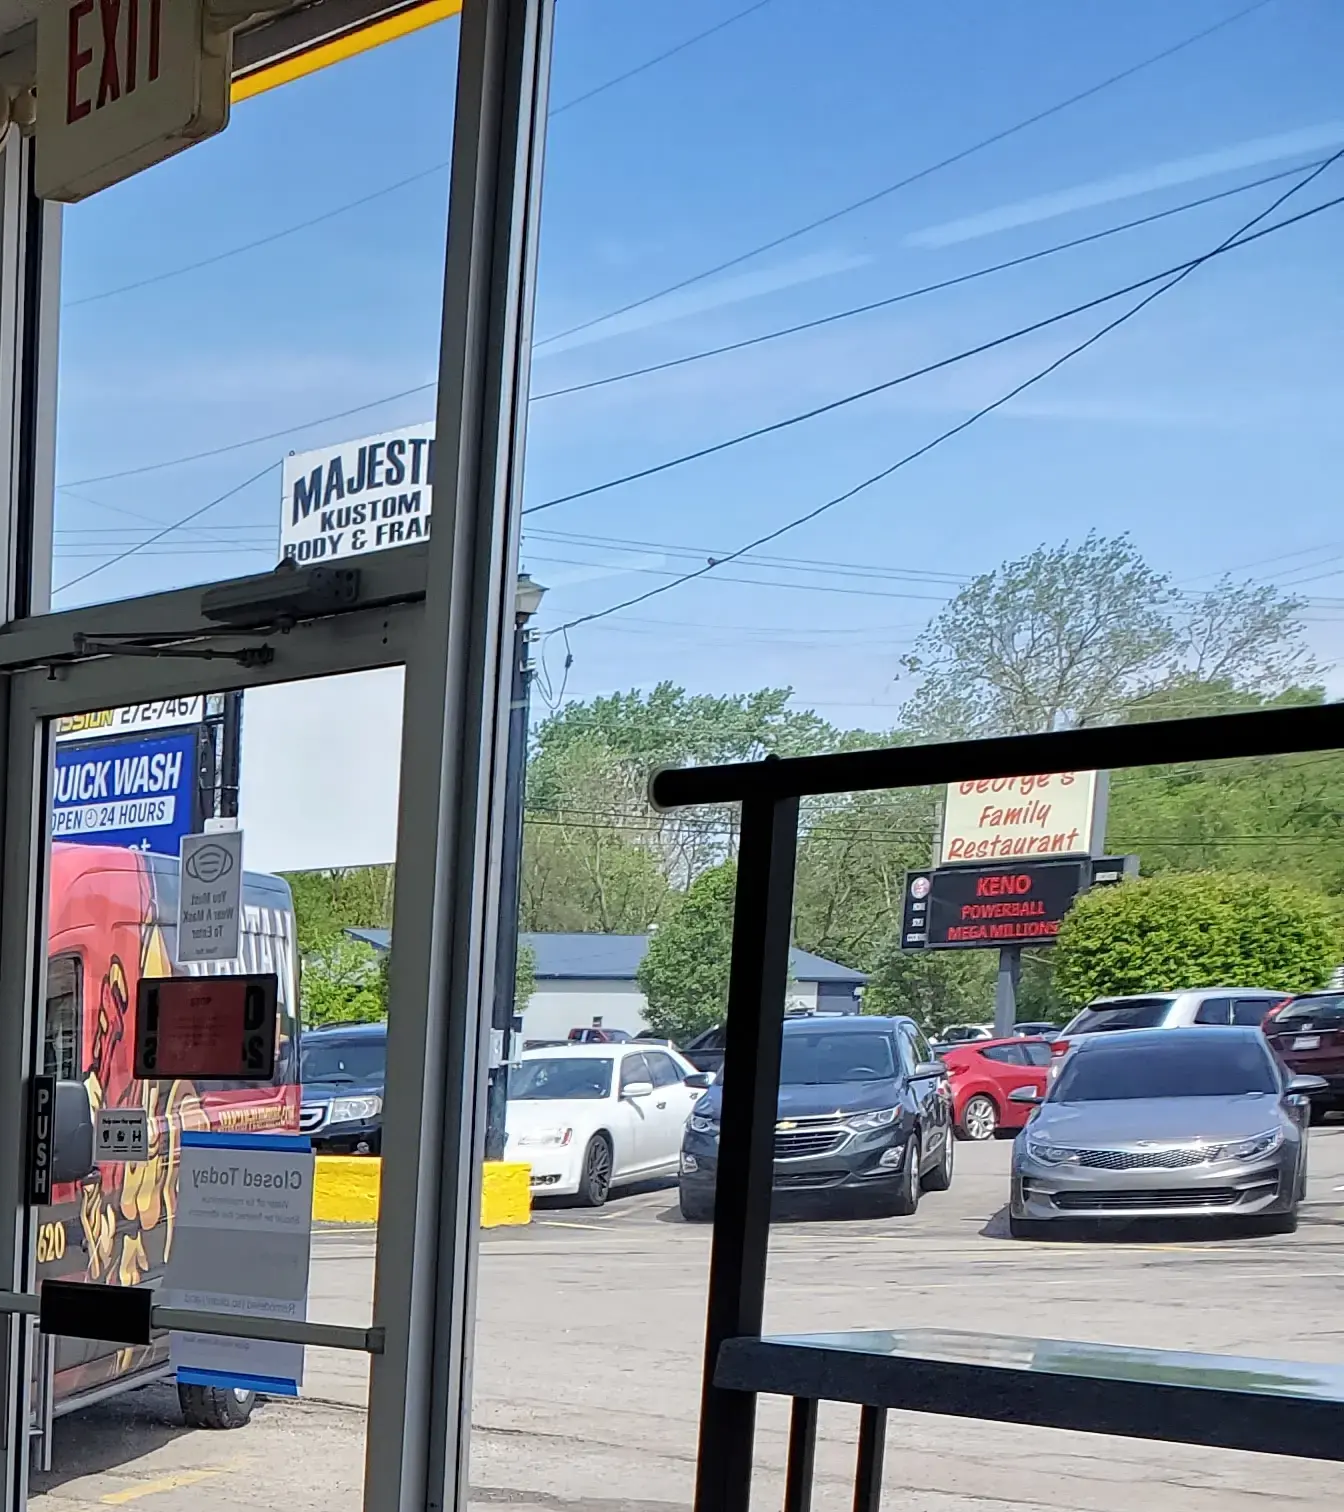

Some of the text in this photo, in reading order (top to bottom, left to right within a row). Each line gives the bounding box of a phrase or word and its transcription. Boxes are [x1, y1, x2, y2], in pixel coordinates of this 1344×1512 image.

[320, 490, 422, 533] KUSTOM
[351, 528, 369, 551] &
[114, 751, 183, 796] WASH
[100, 806, 115, 827] 24
[119, 800, 166, 825] HOURS
[978, 799, 1053, 829] Family
[947, 827, 1080, 861] Restaurant
[975, 874, 1033, 898] KENO
[961, 901, 1047, 920] POWERBALL
[947, 924, 989, 942] MEGA
[990, 919, 1061, 939] MILLIONS
[34, 1088, 50, 1194] PUSH
[37, 1221, 66, 1263] 620
